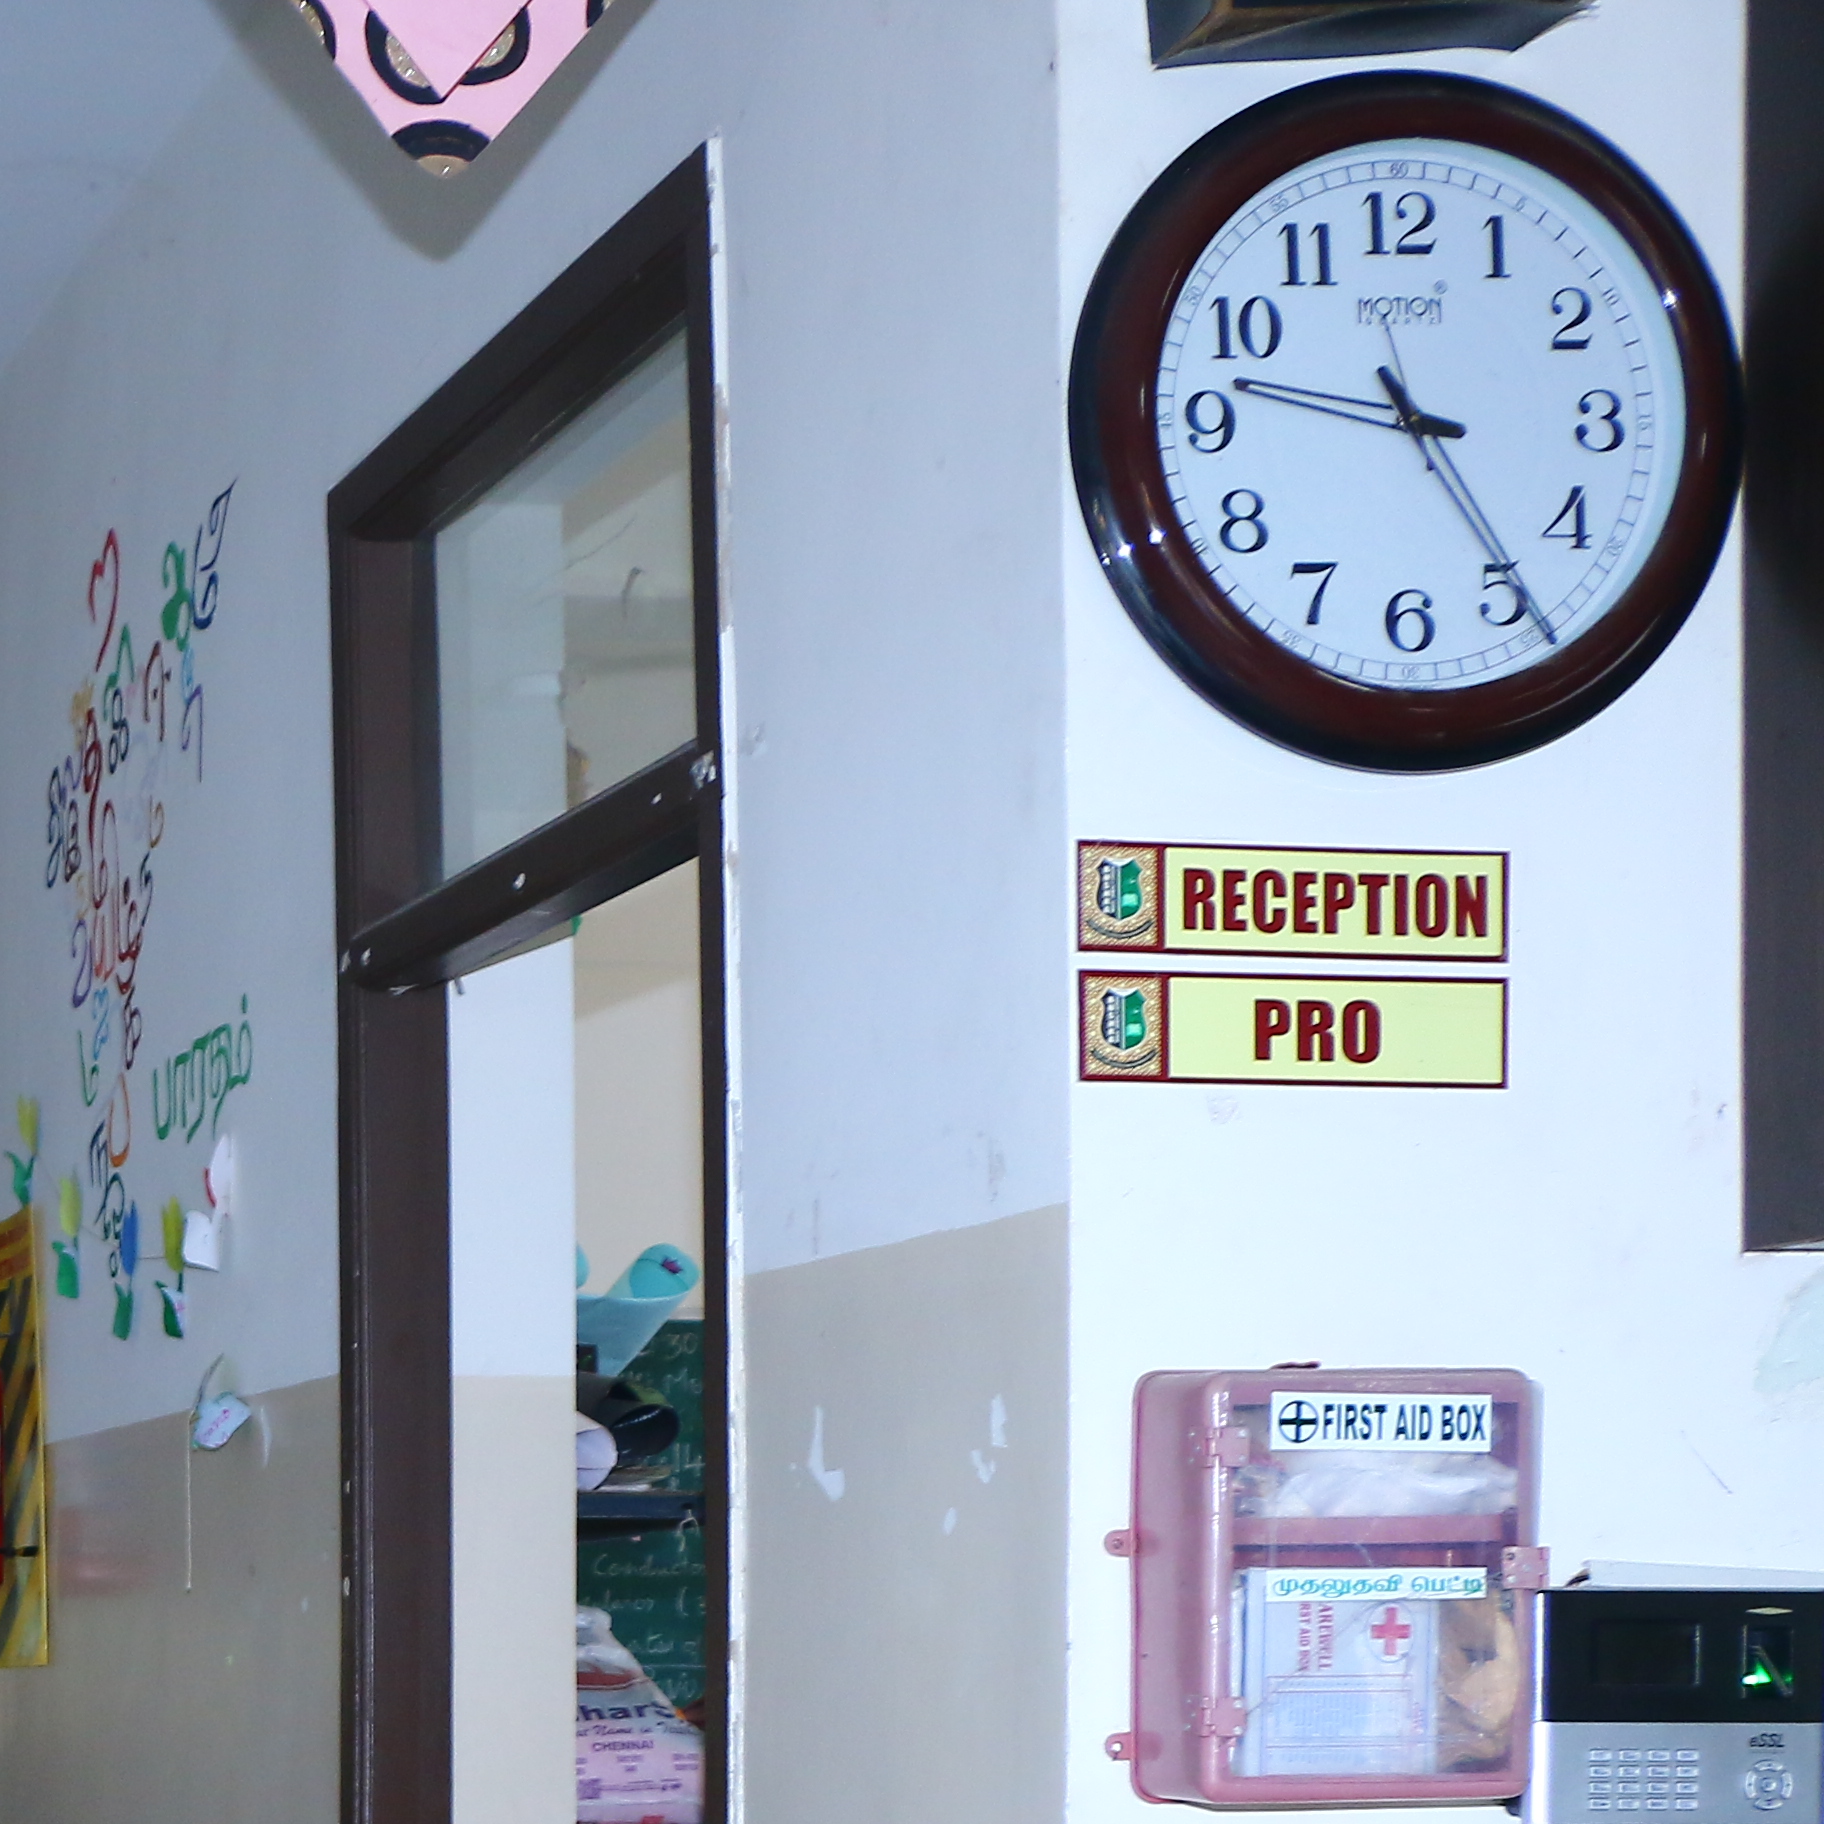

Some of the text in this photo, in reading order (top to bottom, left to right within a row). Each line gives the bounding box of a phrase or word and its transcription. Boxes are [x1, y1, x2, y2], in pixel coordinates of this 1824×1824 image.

[1277, 221, 1339, 288] 11
[1361, 191, 1437, 257] 12
[1481, 214, 1512, 280] 1
[1209, 295, 1283, 360] 10
[1357, 296, 1442, 324] MOTION
[1549, 287, 1593, 351] 2
[1184, 389, 1236, 455] 9
[1573, 389, 1626, 453] 3
[1218, 488, 1270, 554] 8
[1541, 485, 1594, 551] 4
[1289, 561, 1339, 626] 7
[1384, 589, 1436, 653] 6
[1479, 561, 1528, 627] 5
[1181, 867, 1489, 939] RECEPTION
[1253, 998, 1381, 1065] PRO
[1322, 1403, 1487, 1443] FIRST AID BOX
[1273, 1573, 1485, 1598] முதலுதவி பெட்டி
[1299, 1601, 1311, 1624] RST
[1318, 1601, 1333, 1670] AREWELL
[592, 1740, 654, 1752] CHENNAI
[1749, 1733, 1786, 1748] eSSL
